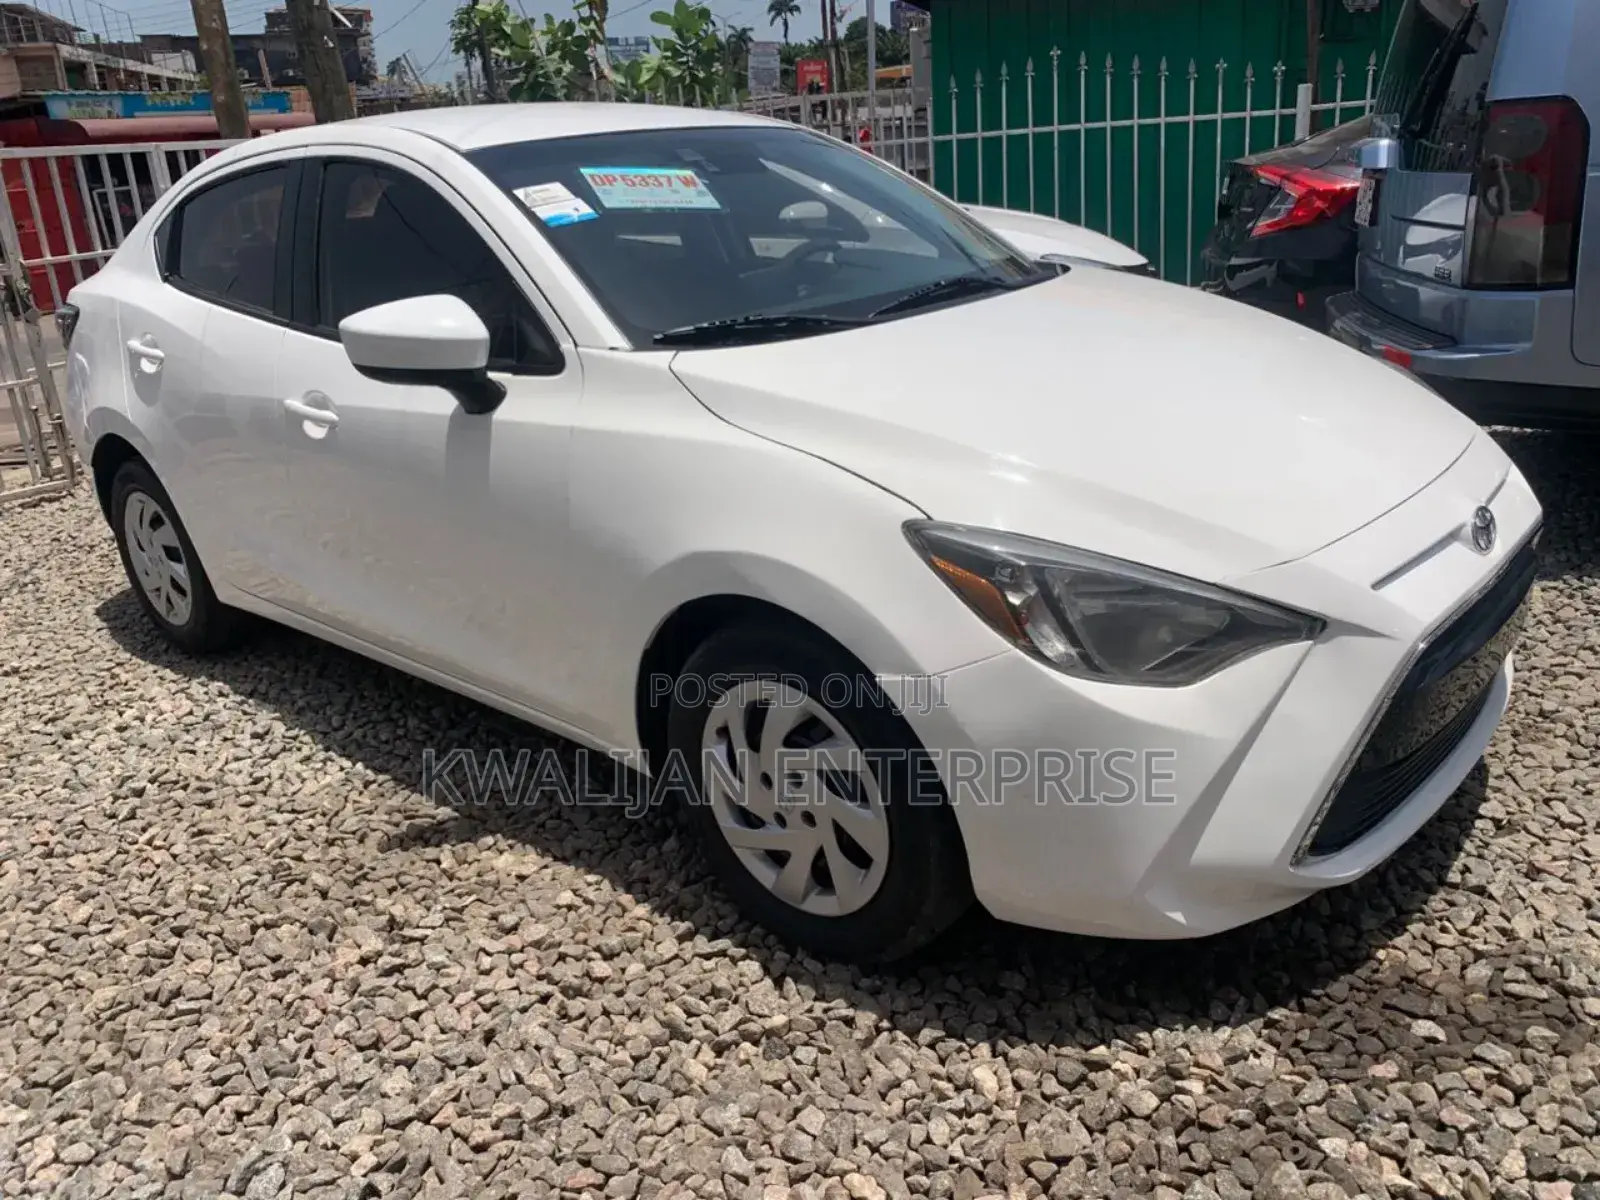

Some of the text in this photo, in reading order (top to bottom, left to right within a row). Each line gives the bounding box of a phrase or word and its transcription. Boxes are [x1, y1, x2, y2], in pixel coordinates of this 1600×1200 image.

[589, 173, 699, 189] DP 5337 W
